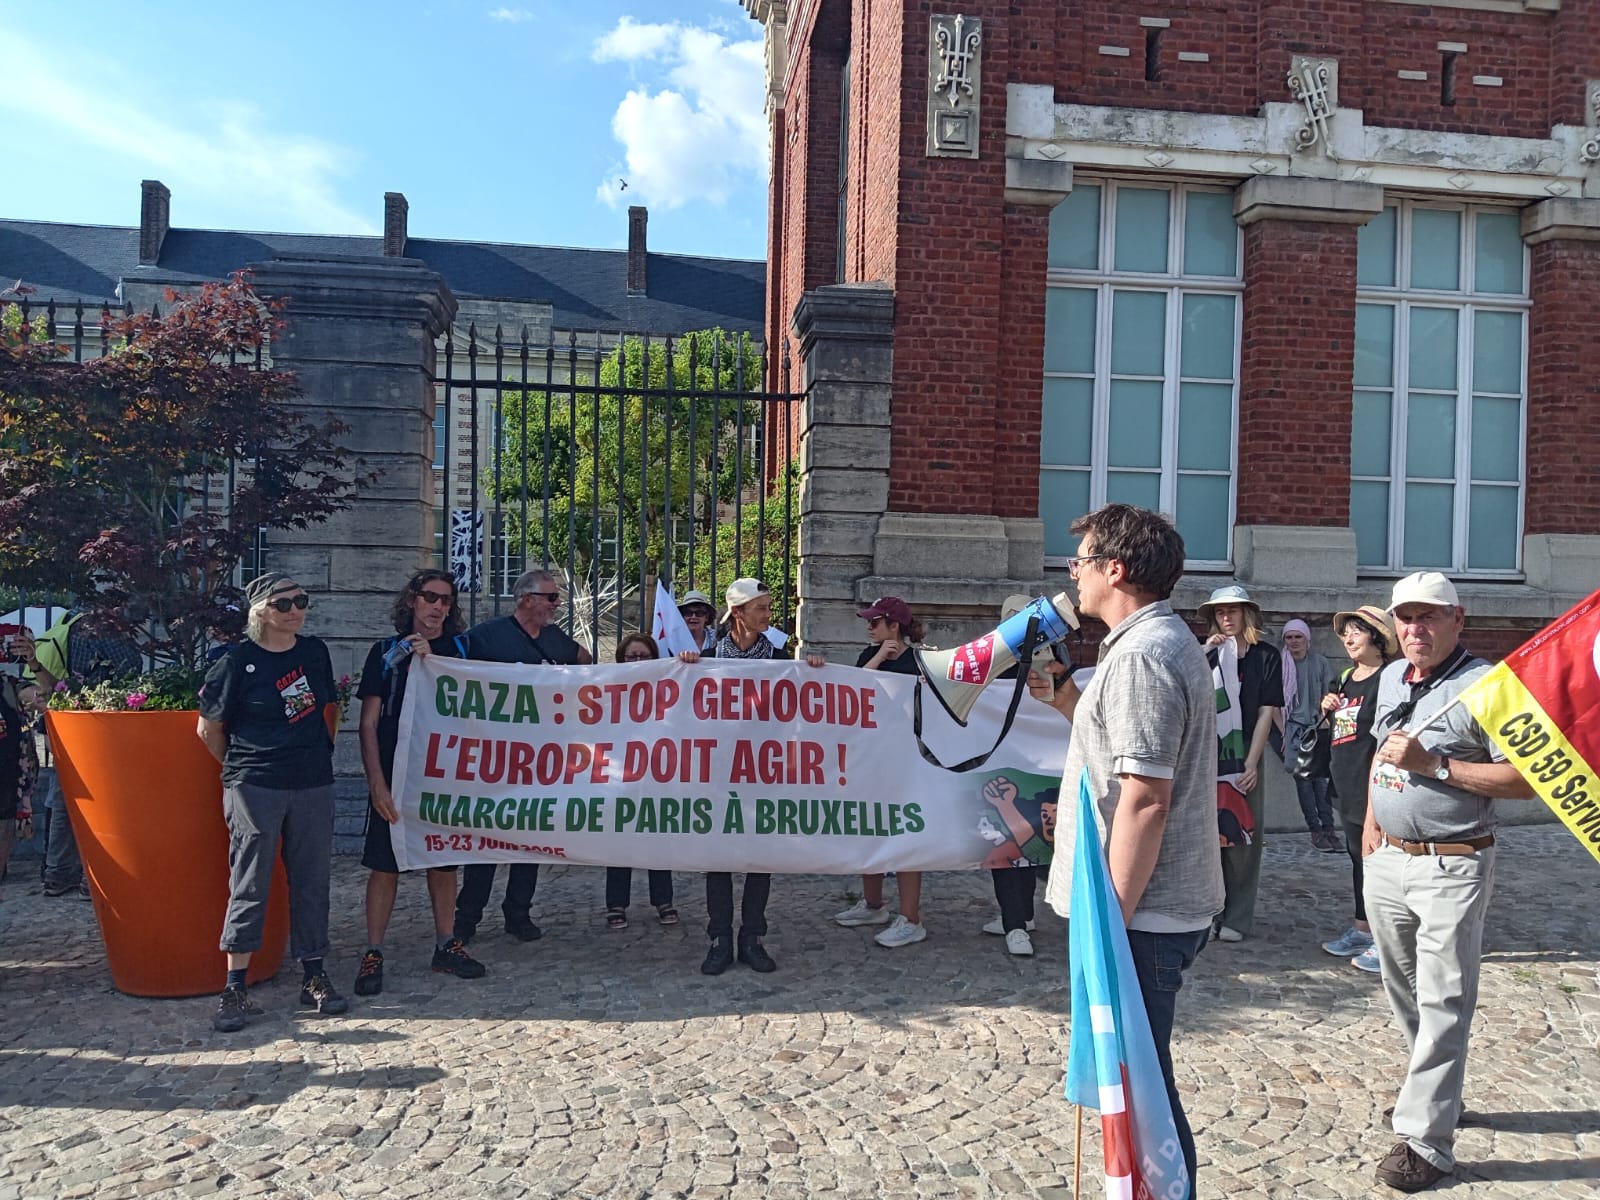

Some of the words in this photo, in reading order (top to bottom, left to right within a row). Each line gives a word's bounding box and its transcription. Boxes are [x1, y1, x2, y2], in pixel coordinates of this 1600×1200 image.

[435, 675, 540, 724] GAZA
[553, 693, 565, 724] :
[577, 678, 680, 725] STOP
[693, 677, 877, 728] GENOCIDE
[424, 733, 613, 786] L'EUROPE
[623, 737, 717, 784] DOIT
[730, 739, 825, 785] AGIR
[838, 743, 847, 786] !
[1499, 712, 1550, 758] CSD
[1530, 748, 1573, 783] 59
[419, 792, 557, 832] MARCHE
[566, 797, 605, 832] DE
[615, 797, 712, 834] PARIS
[723, 791, 744, 834] À
[755, 796, 925, 837] BRUXELLES
[424, 834, 472, 852] 15-23
